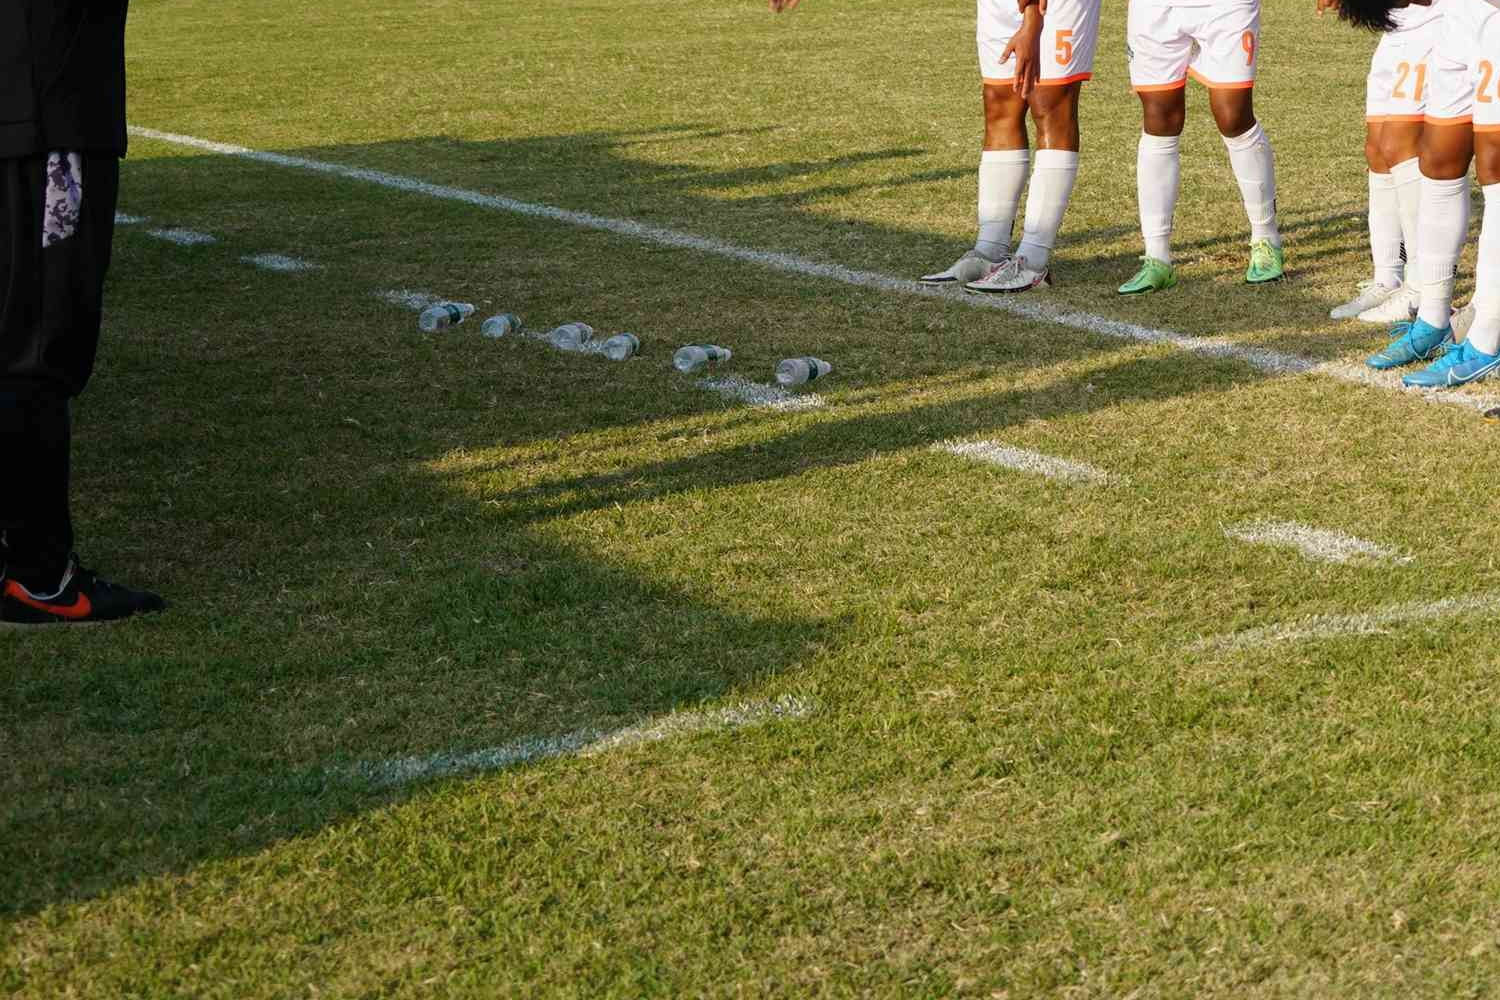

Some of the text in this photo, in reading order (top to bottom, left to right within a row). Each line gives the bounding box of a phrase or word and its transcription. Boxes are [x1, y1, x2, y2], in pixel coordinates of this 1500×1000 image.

[1055, 29, 1073, 65] 5
[1241, 30, 1255, 66] 9
[1391, 62, 1427, 103] 21
